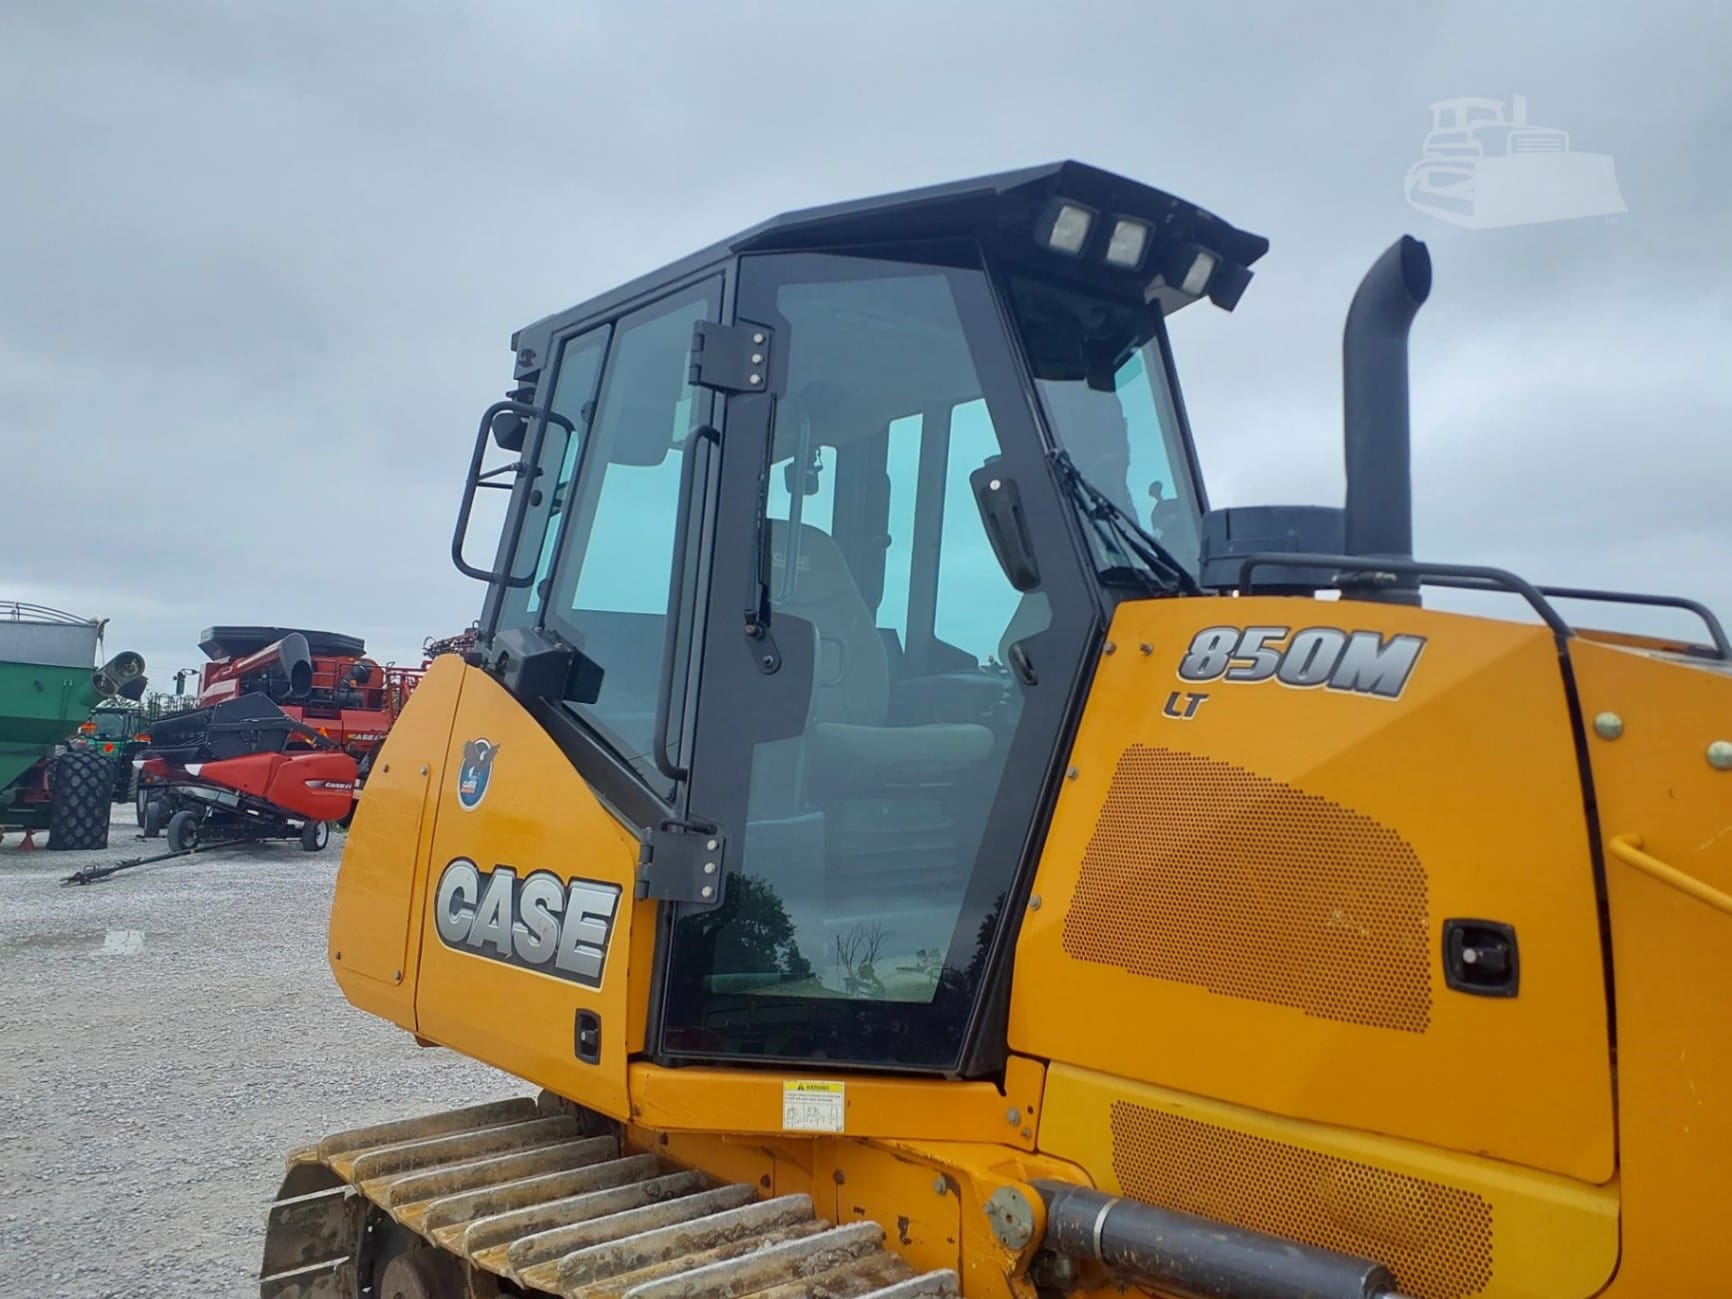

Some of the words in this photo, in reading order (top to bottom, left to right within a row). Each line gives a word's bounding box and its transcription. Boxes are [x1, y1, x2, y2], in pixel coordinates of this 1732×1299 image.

[1179, 625, 1427, 698] 850M
[1163, 691, 1209, 718] LT
[436, 857, 620, 979] CASE
